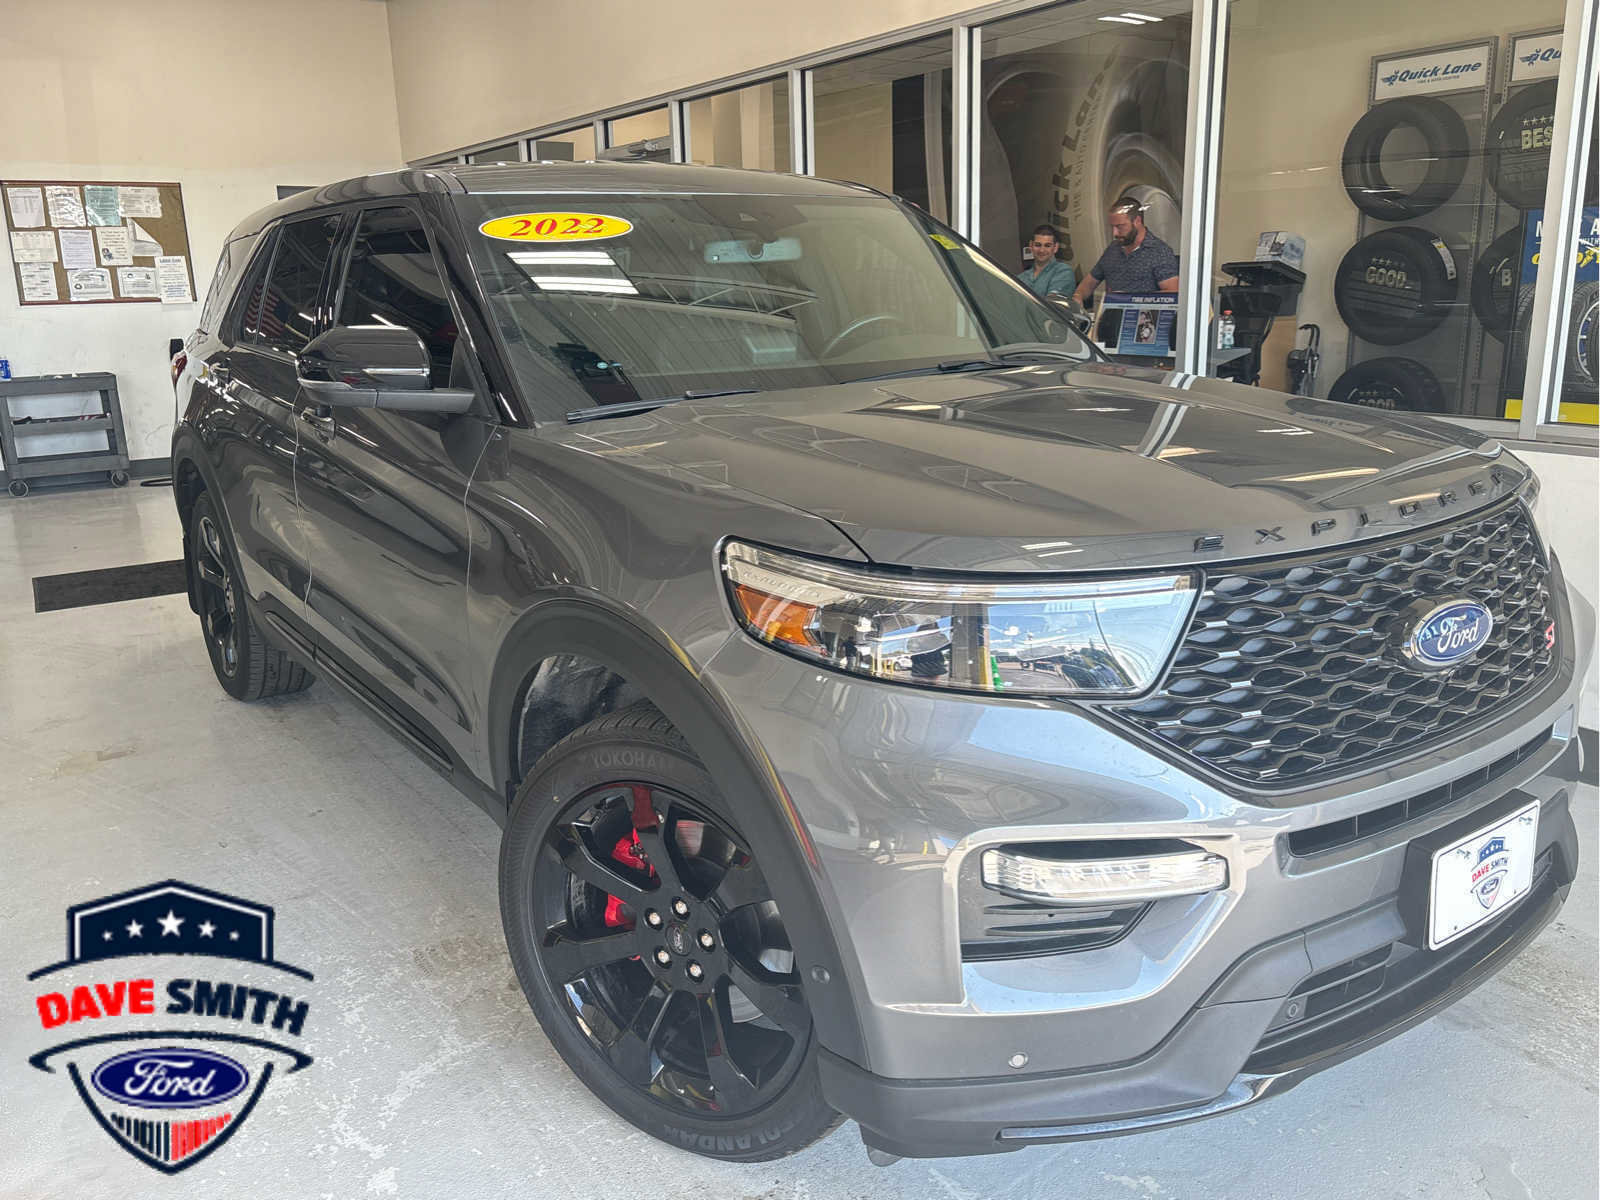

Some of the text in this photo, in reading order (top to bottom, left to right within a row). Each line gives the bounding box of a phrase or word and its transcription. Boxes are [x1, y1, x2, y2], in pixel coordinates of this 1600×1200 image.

[1399, 66, 1441, 82] Quick
[1442, 62, 1482, 76] Lane
[1520, 126, 1553, 151] BES
[509, 217, 604, 237] 2022
[1048, 162, 1081, 276] uick
[1365, 266, 1408, 289] GOOD
[1193, 471, 1505, 552] EXPLORER
[1437, 614, 1480, 653] Ford
[1471, 864, 1490, 883] DAVE
